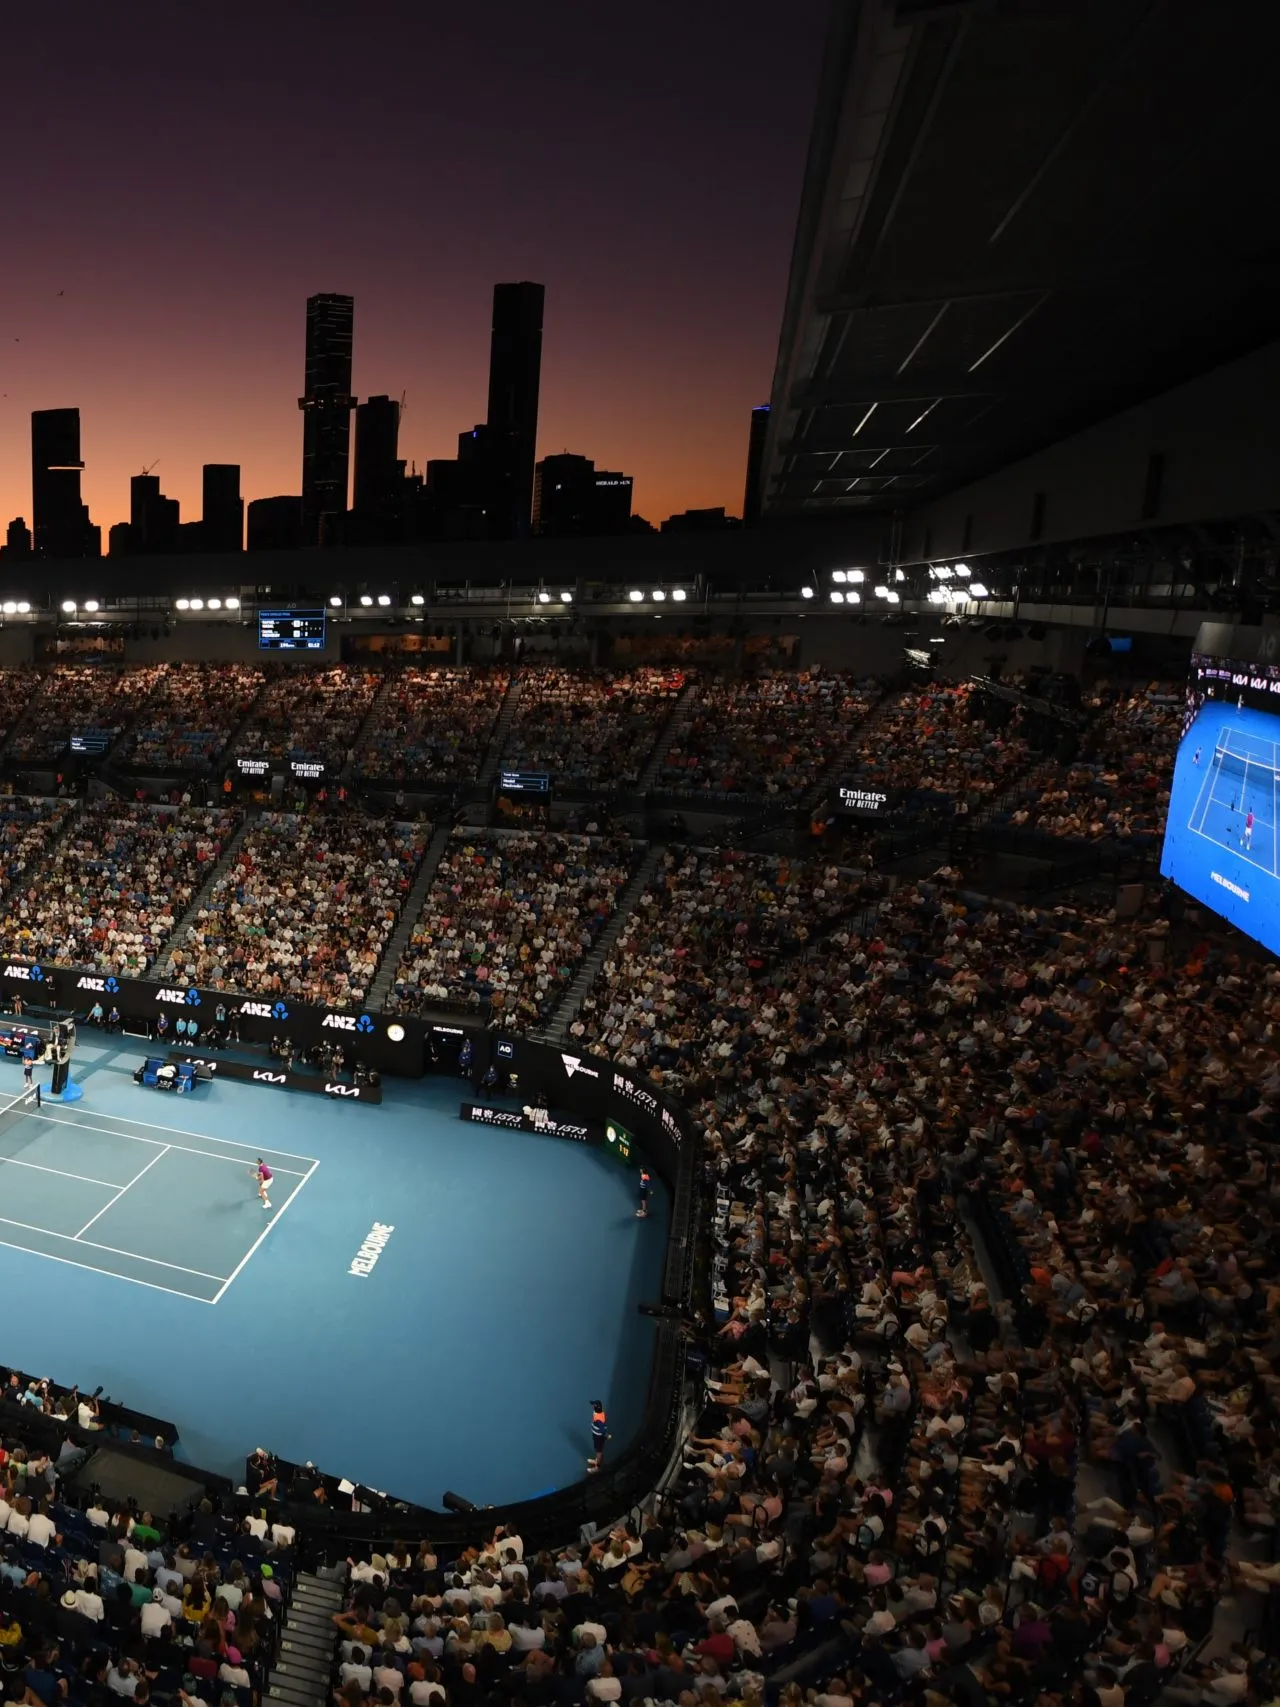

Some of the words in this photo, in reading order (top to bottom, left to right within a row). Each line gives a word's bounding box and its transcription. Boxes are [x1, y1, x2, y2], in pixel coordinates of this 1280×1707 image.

[237, 760, 269, 768] Emirates
[291, 762, 324, 771] Emirates
[840, 788, 887, 802] Emirates
[845, 799, 856, 807] FLY
[857, 800, 879, 809] BETTER
[4, 966, 30, 981] ANZ
[77, 976, 104, 991] ANZ
[155, 989, 186, 1004] ANZ
[240, 1002, 272, 1017] ANZ
[322, 1014, 356, 1031] ANZ
[433, 1026, 464, 1035] MELBOURNE
[500, 1045, 511, 1053] AO
[253, 1070, 286, 1083] KIA
[325, 1083, 360, 1097] KIA
[634, 1090, 658, 1108] 1573
[494, 1113, 522, 1122] 1573
[558, 1125, 587, 1135] 1573
[347, 1222, 395, 1278] MELBOURNE
